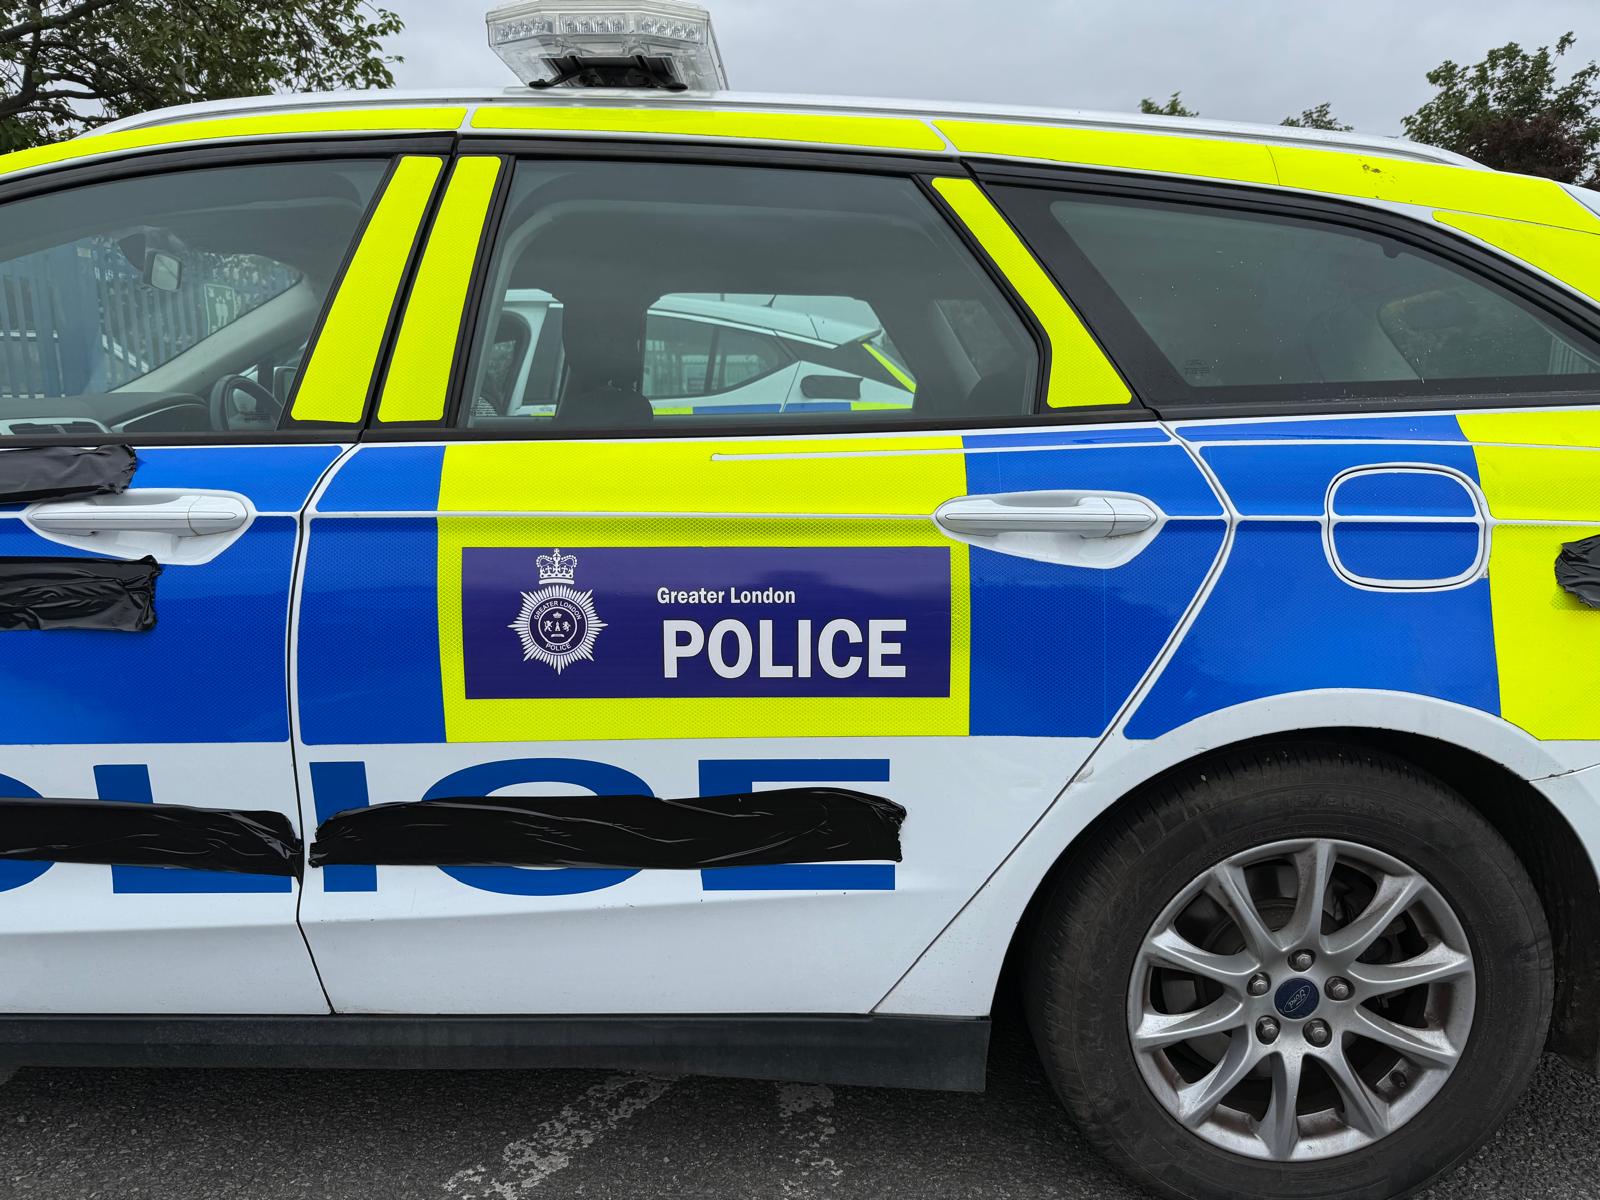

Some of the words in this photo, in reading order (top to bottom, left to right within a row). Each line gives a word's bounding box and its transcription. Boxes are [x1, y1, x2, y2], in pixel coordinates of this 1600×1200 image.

[656, 586, 724, 605] Greater
[731, 586, 796, 605] London
[534, 601, 559, 620] GREATER
[559, 601, 582, 620] LONDON
[545, 642, 572, 651] POLICE
[663, 618, 907, 679] POLICE
